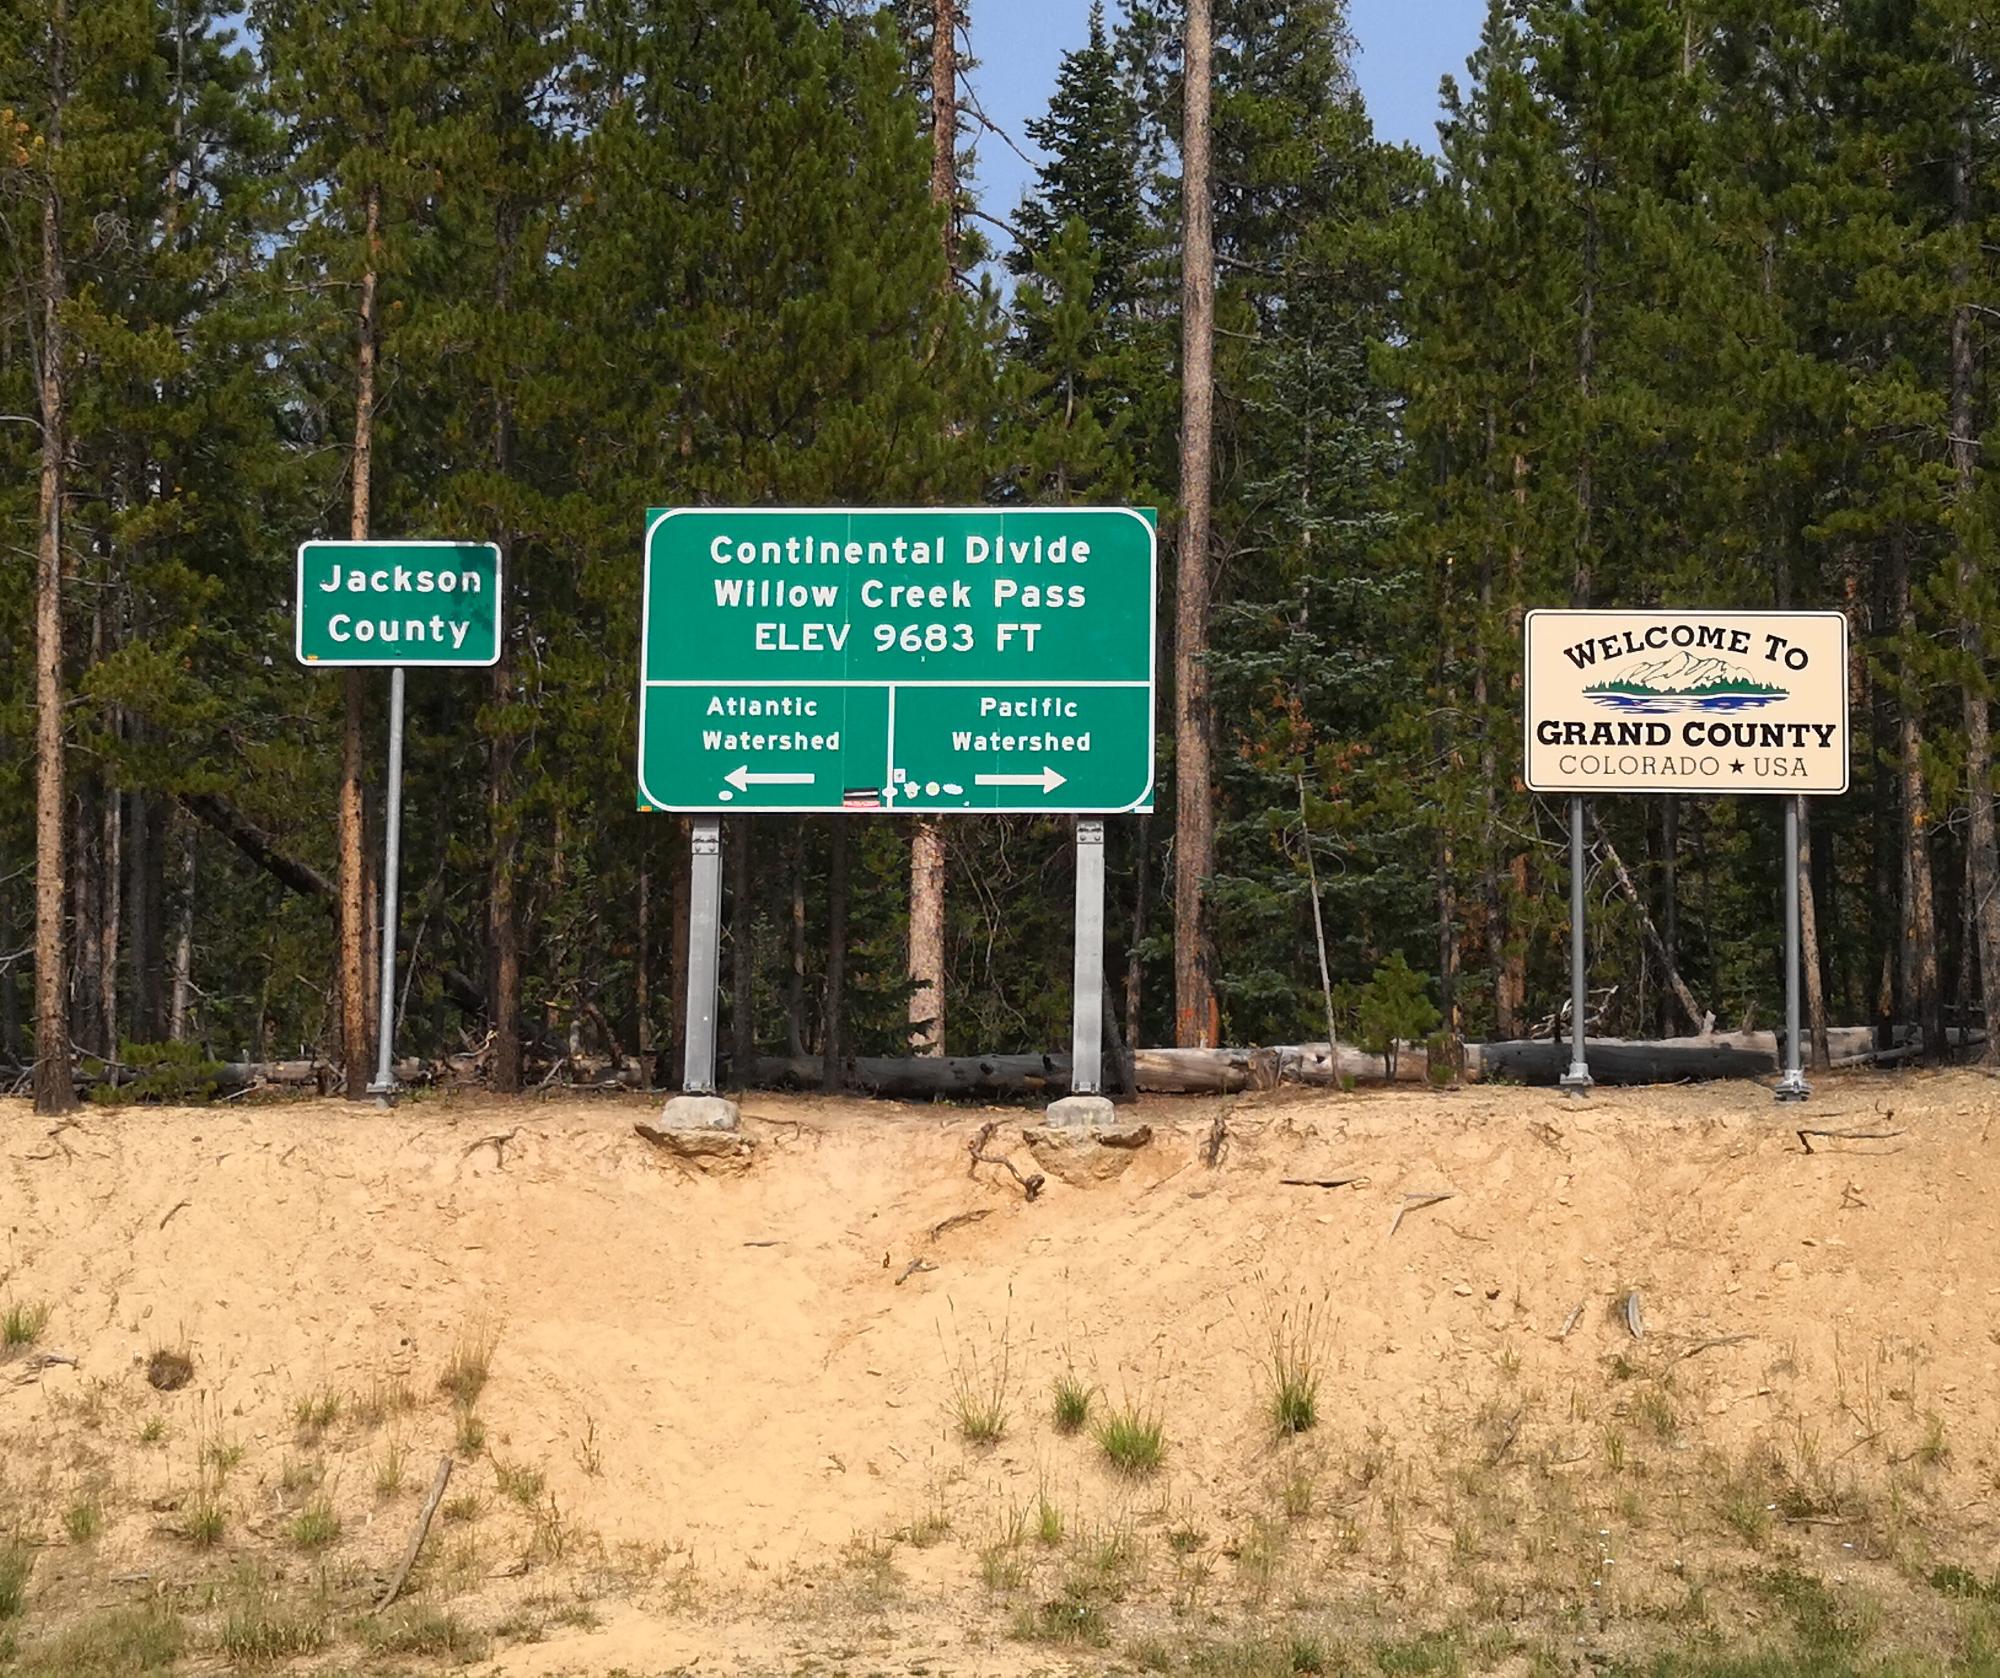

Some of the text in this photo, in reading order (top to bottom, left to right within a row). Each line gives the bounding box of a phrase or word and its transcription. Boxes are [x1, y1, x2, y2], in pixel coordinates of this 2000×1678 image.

[710, 535, 1091, 564] Continental Divide
[319, 564, 481, 593] Jackson
[714, 579, 1086, 608] Willow Creek Pass
[328, 613, 470, 649] County
[755, 623, 1042, 652] ELEV 9683 FT
[1563, 625, 1809, 671] WELCOME TO
[706, 696, 818, 717] Atlantic
[980, 697, 1078, 718] Pacific
[702, 730, 840, 752] Watershed
[952, 731, 1091, 753] Watershed
[1536, 720, 1836, 748] GRAND COUNTY
[1559, 755, 1809, 777] COLORADO USA
